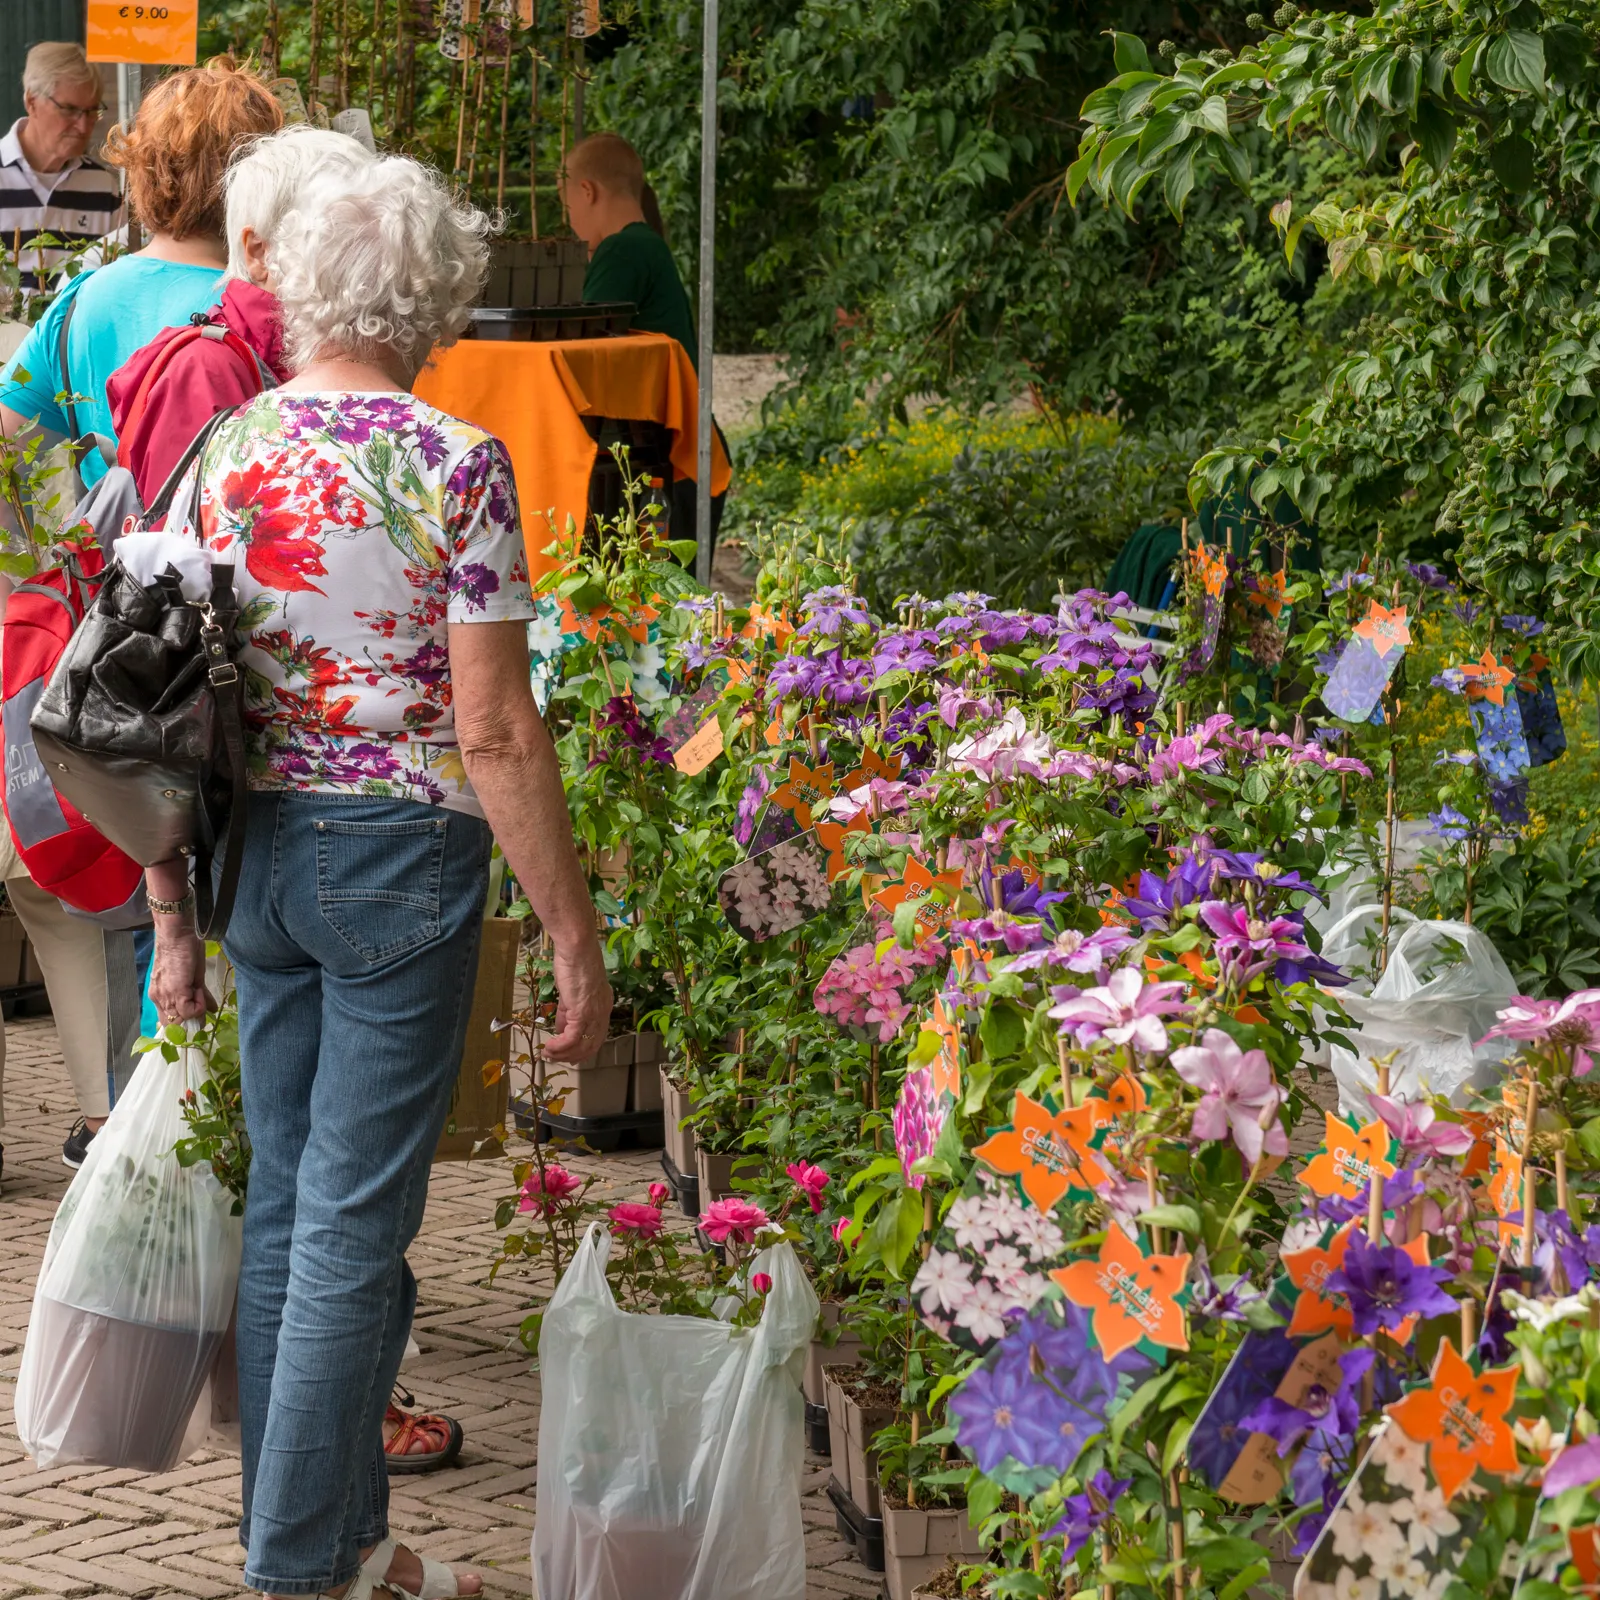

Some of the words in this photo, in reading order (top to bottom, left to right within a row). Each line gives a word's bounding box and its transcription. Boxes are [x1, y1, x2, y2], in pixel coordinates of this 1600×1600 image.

[118, 6, 129, 18] €
[135, 6, 169, 19] 9.00
[1107, 1261, 1165, 1319] Clematis
[1439, 1386, 1496, 1446] Clematis
